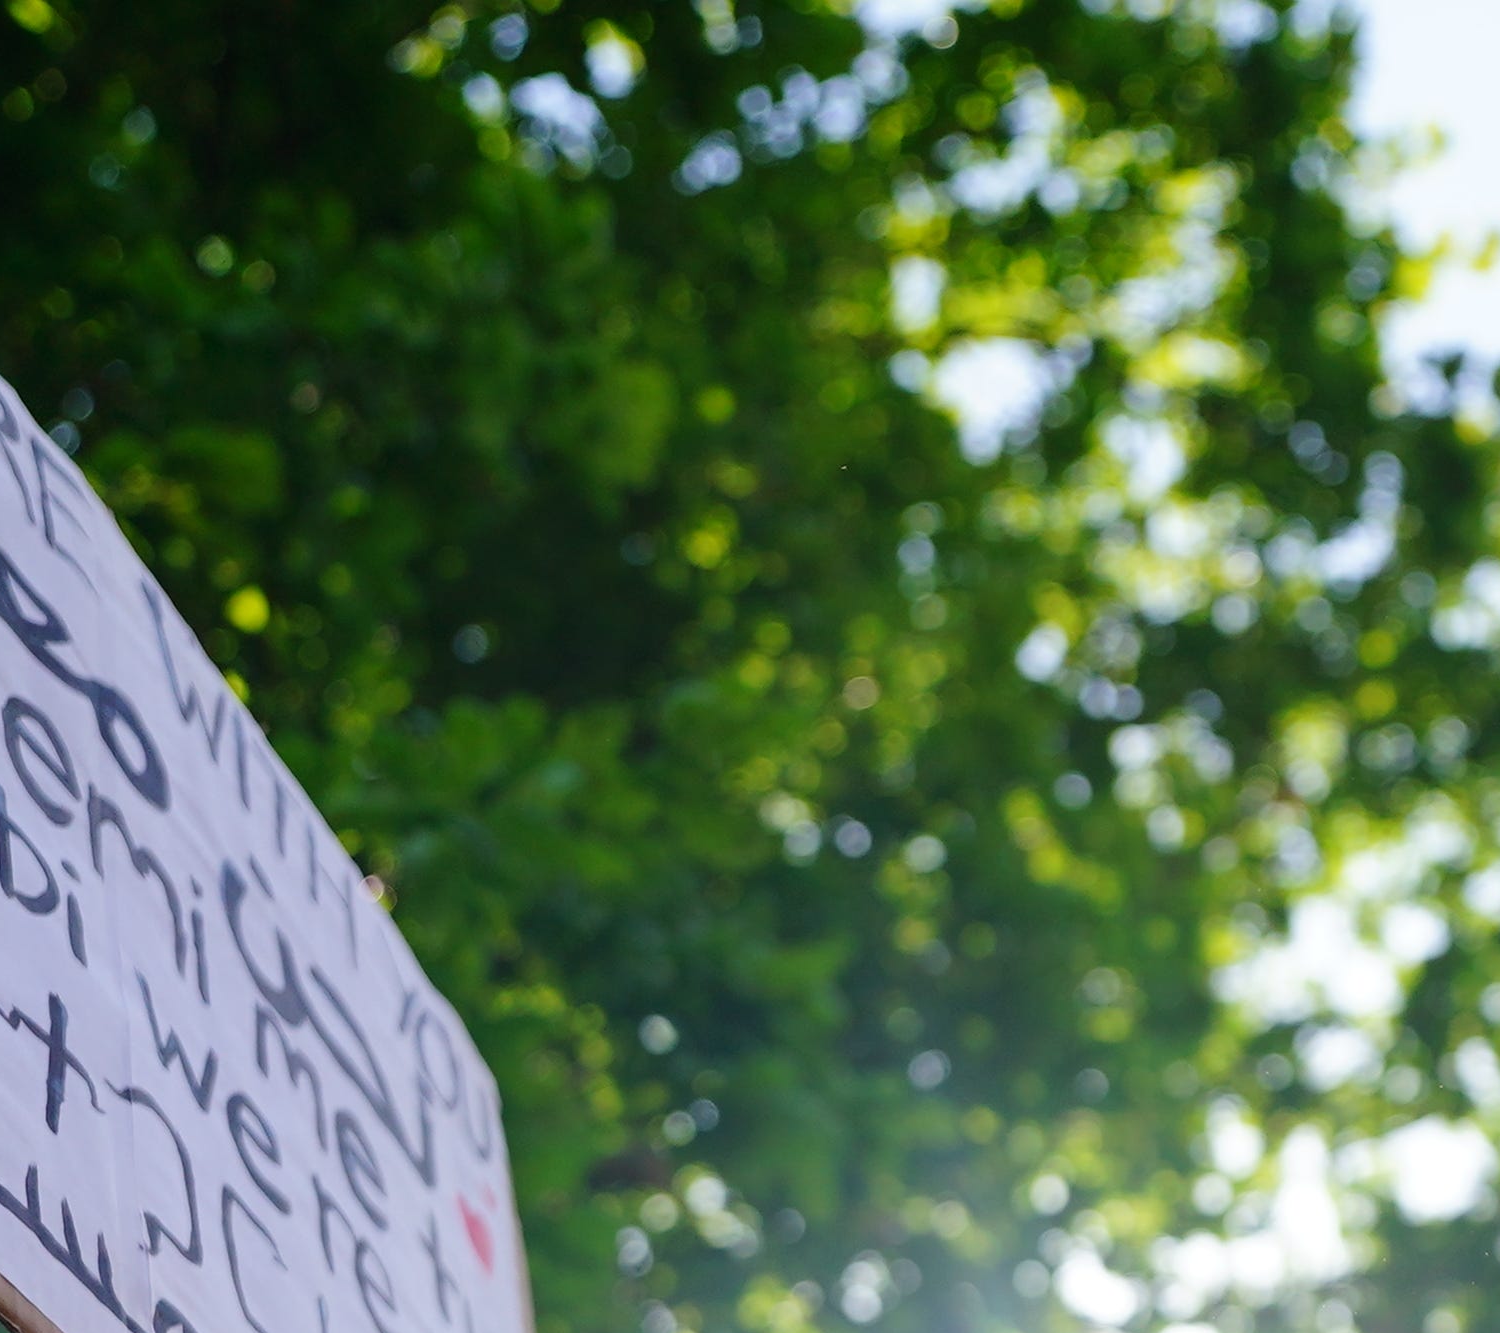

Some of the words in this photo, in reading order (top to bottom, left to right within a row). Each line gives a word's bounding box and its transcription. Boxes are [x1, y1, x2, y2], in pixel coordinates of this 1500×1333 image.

[139, 580, 358, 967] WITH
[385, 926, 495, 1162] YOU
[253, 990, 389, 1232] me
